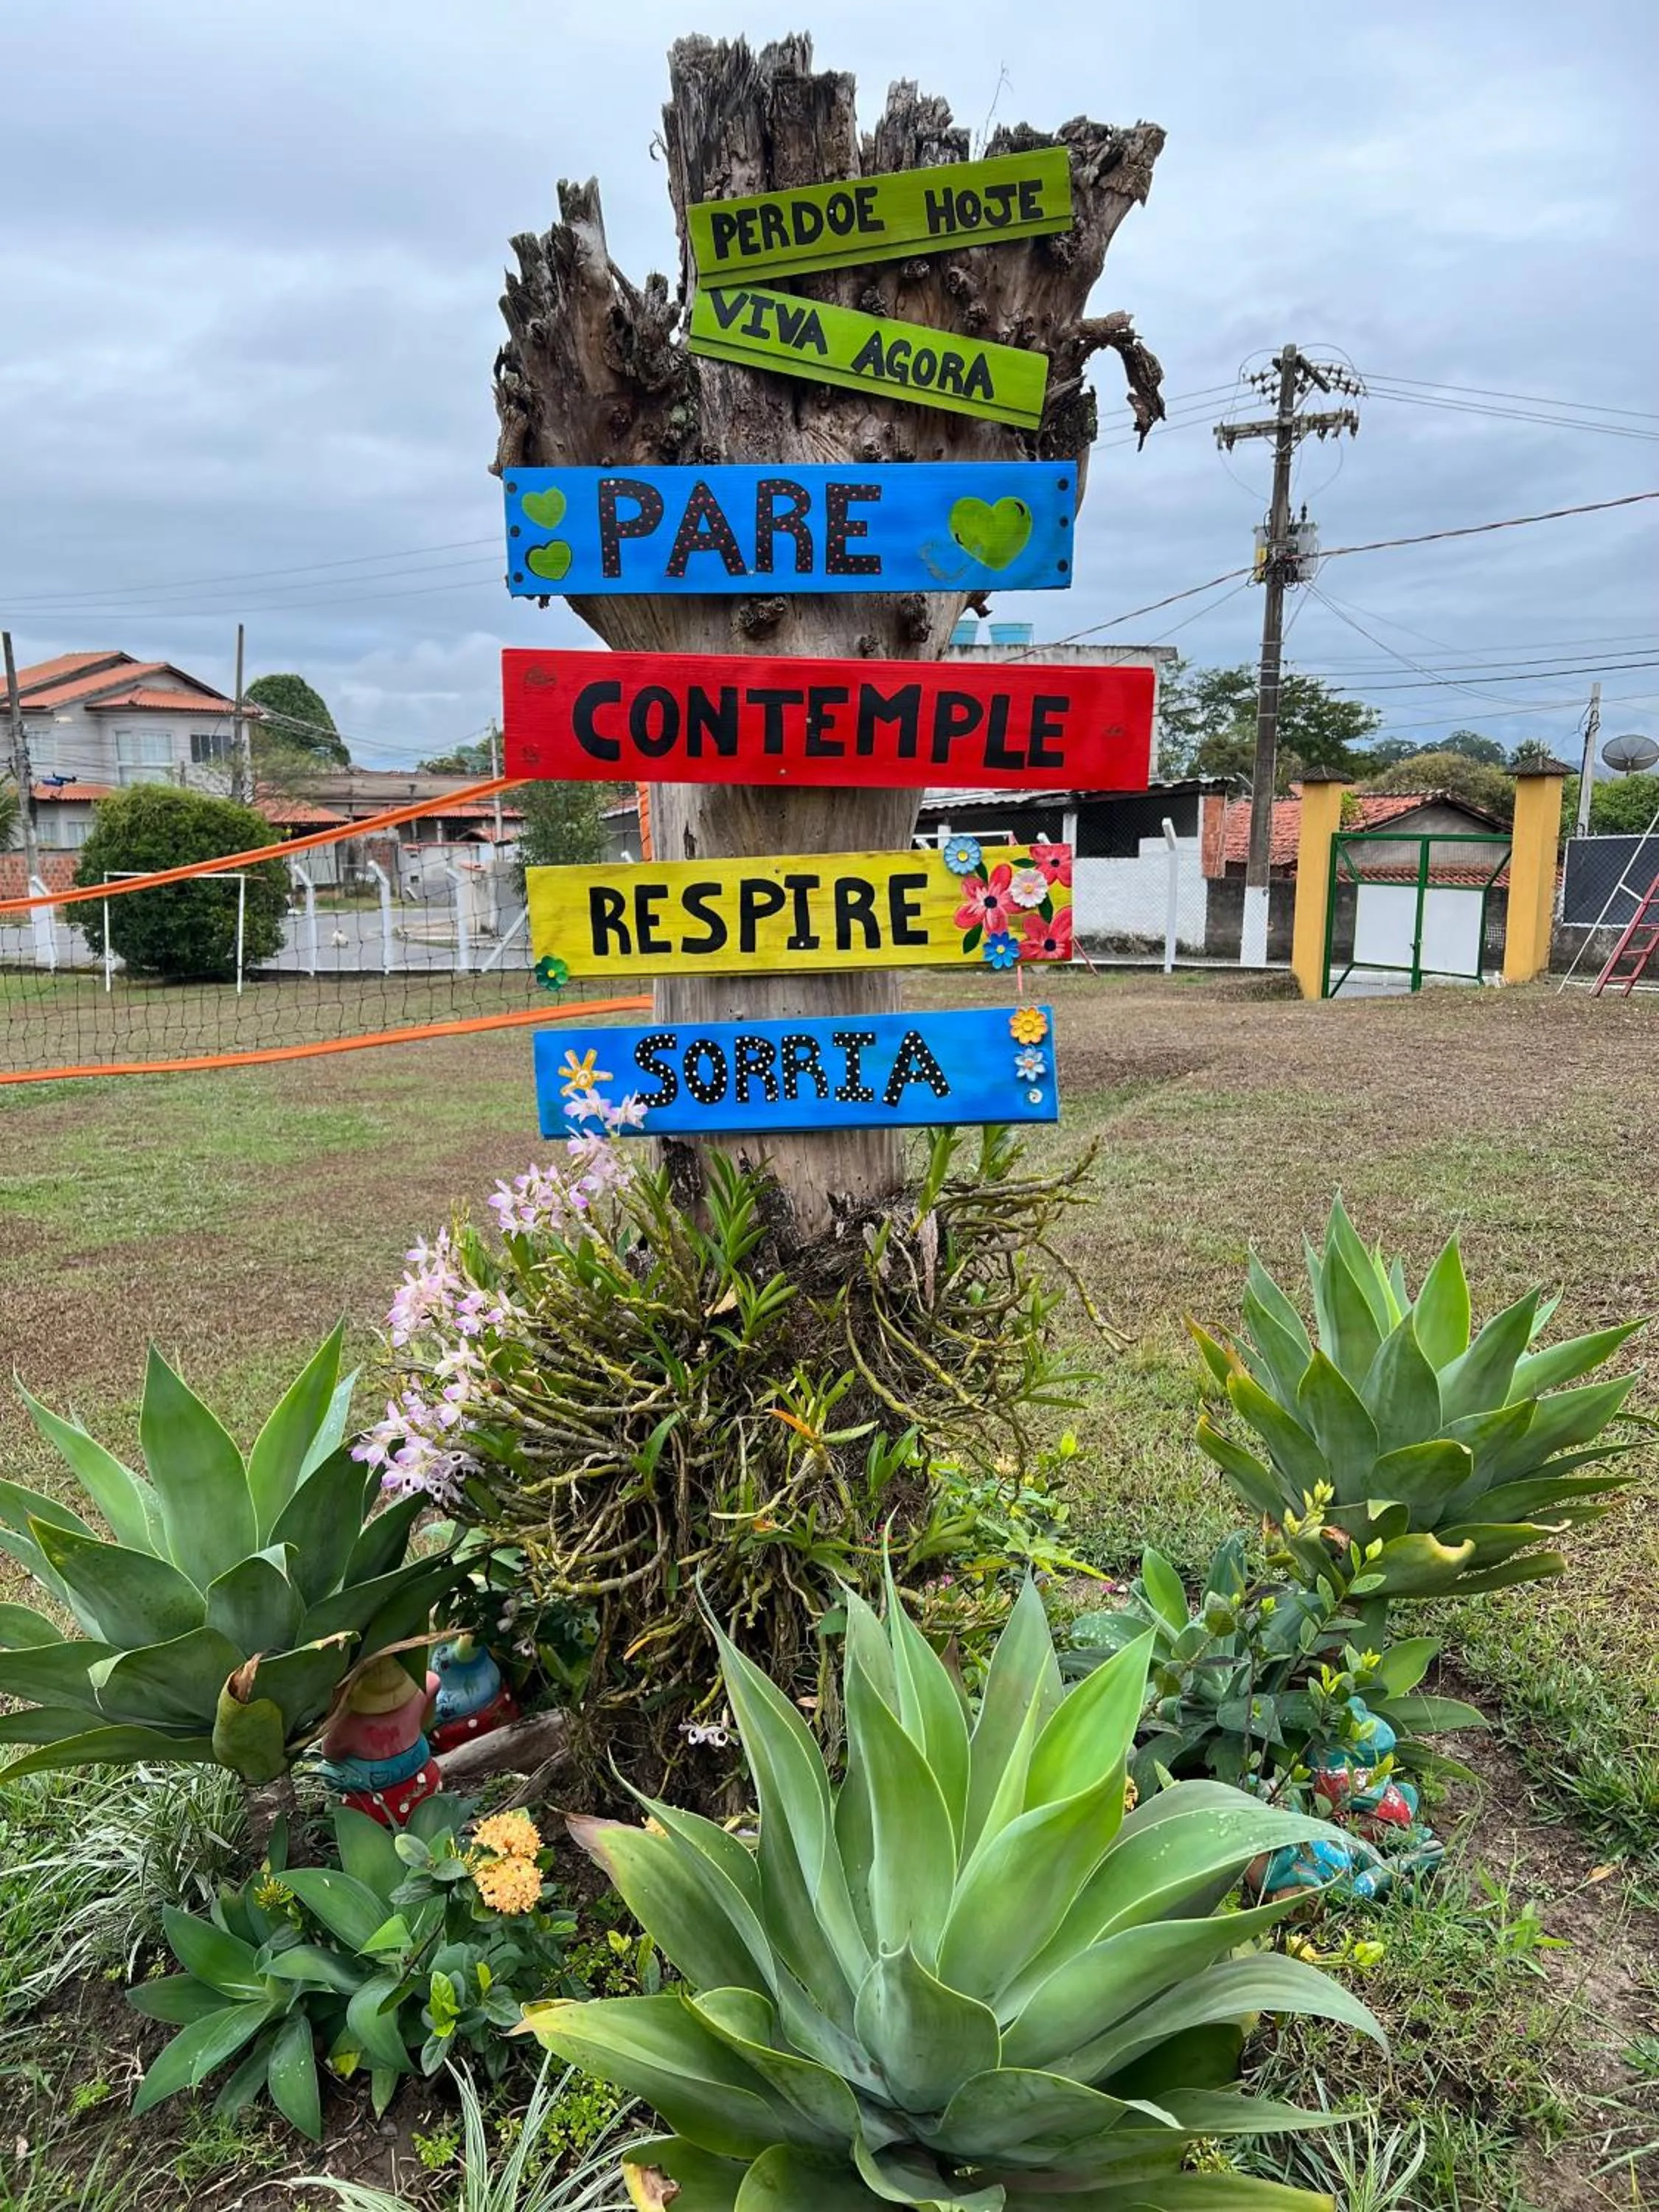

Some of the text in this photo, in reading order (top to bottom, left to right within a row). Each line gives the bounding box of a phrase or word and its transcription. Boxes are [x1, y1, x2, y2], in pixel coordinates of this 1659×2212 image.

[710, 178, 1043, 260] PERDOE HOJE
[709, 289, 995, 400] VIVA AGORA
[598, 478, 883, 578] PARE
[571, 680, 1071, 771] CONTEMPLE
[589, 873, 929, 956] RESPIRE
[633, 1031, 951, 1109] SORRIA
